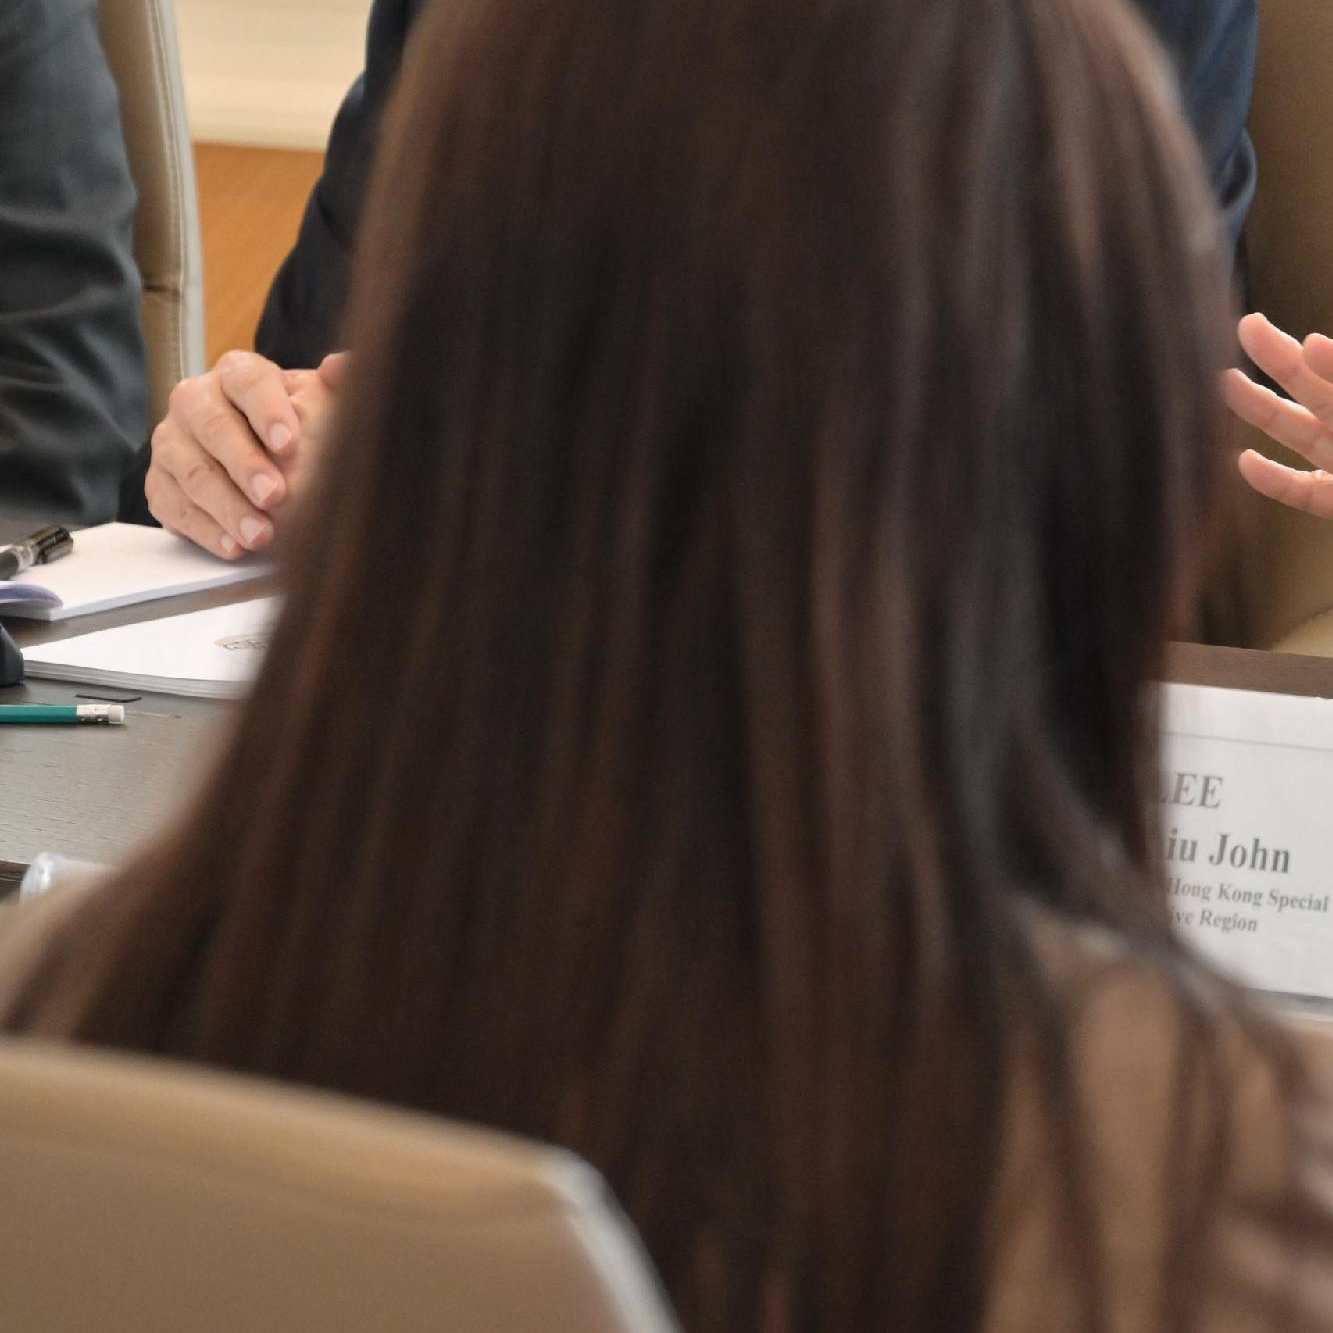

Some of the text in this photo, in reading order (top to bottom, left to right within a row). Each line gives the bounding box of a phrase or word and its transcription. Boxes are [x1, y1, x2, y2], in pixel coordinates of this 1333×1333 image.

[1166, 827, 1290, 874] iu John
[1167, 877, 1329, 913] Hong Kong Special
[1200, 909, 1258, 933] Region
